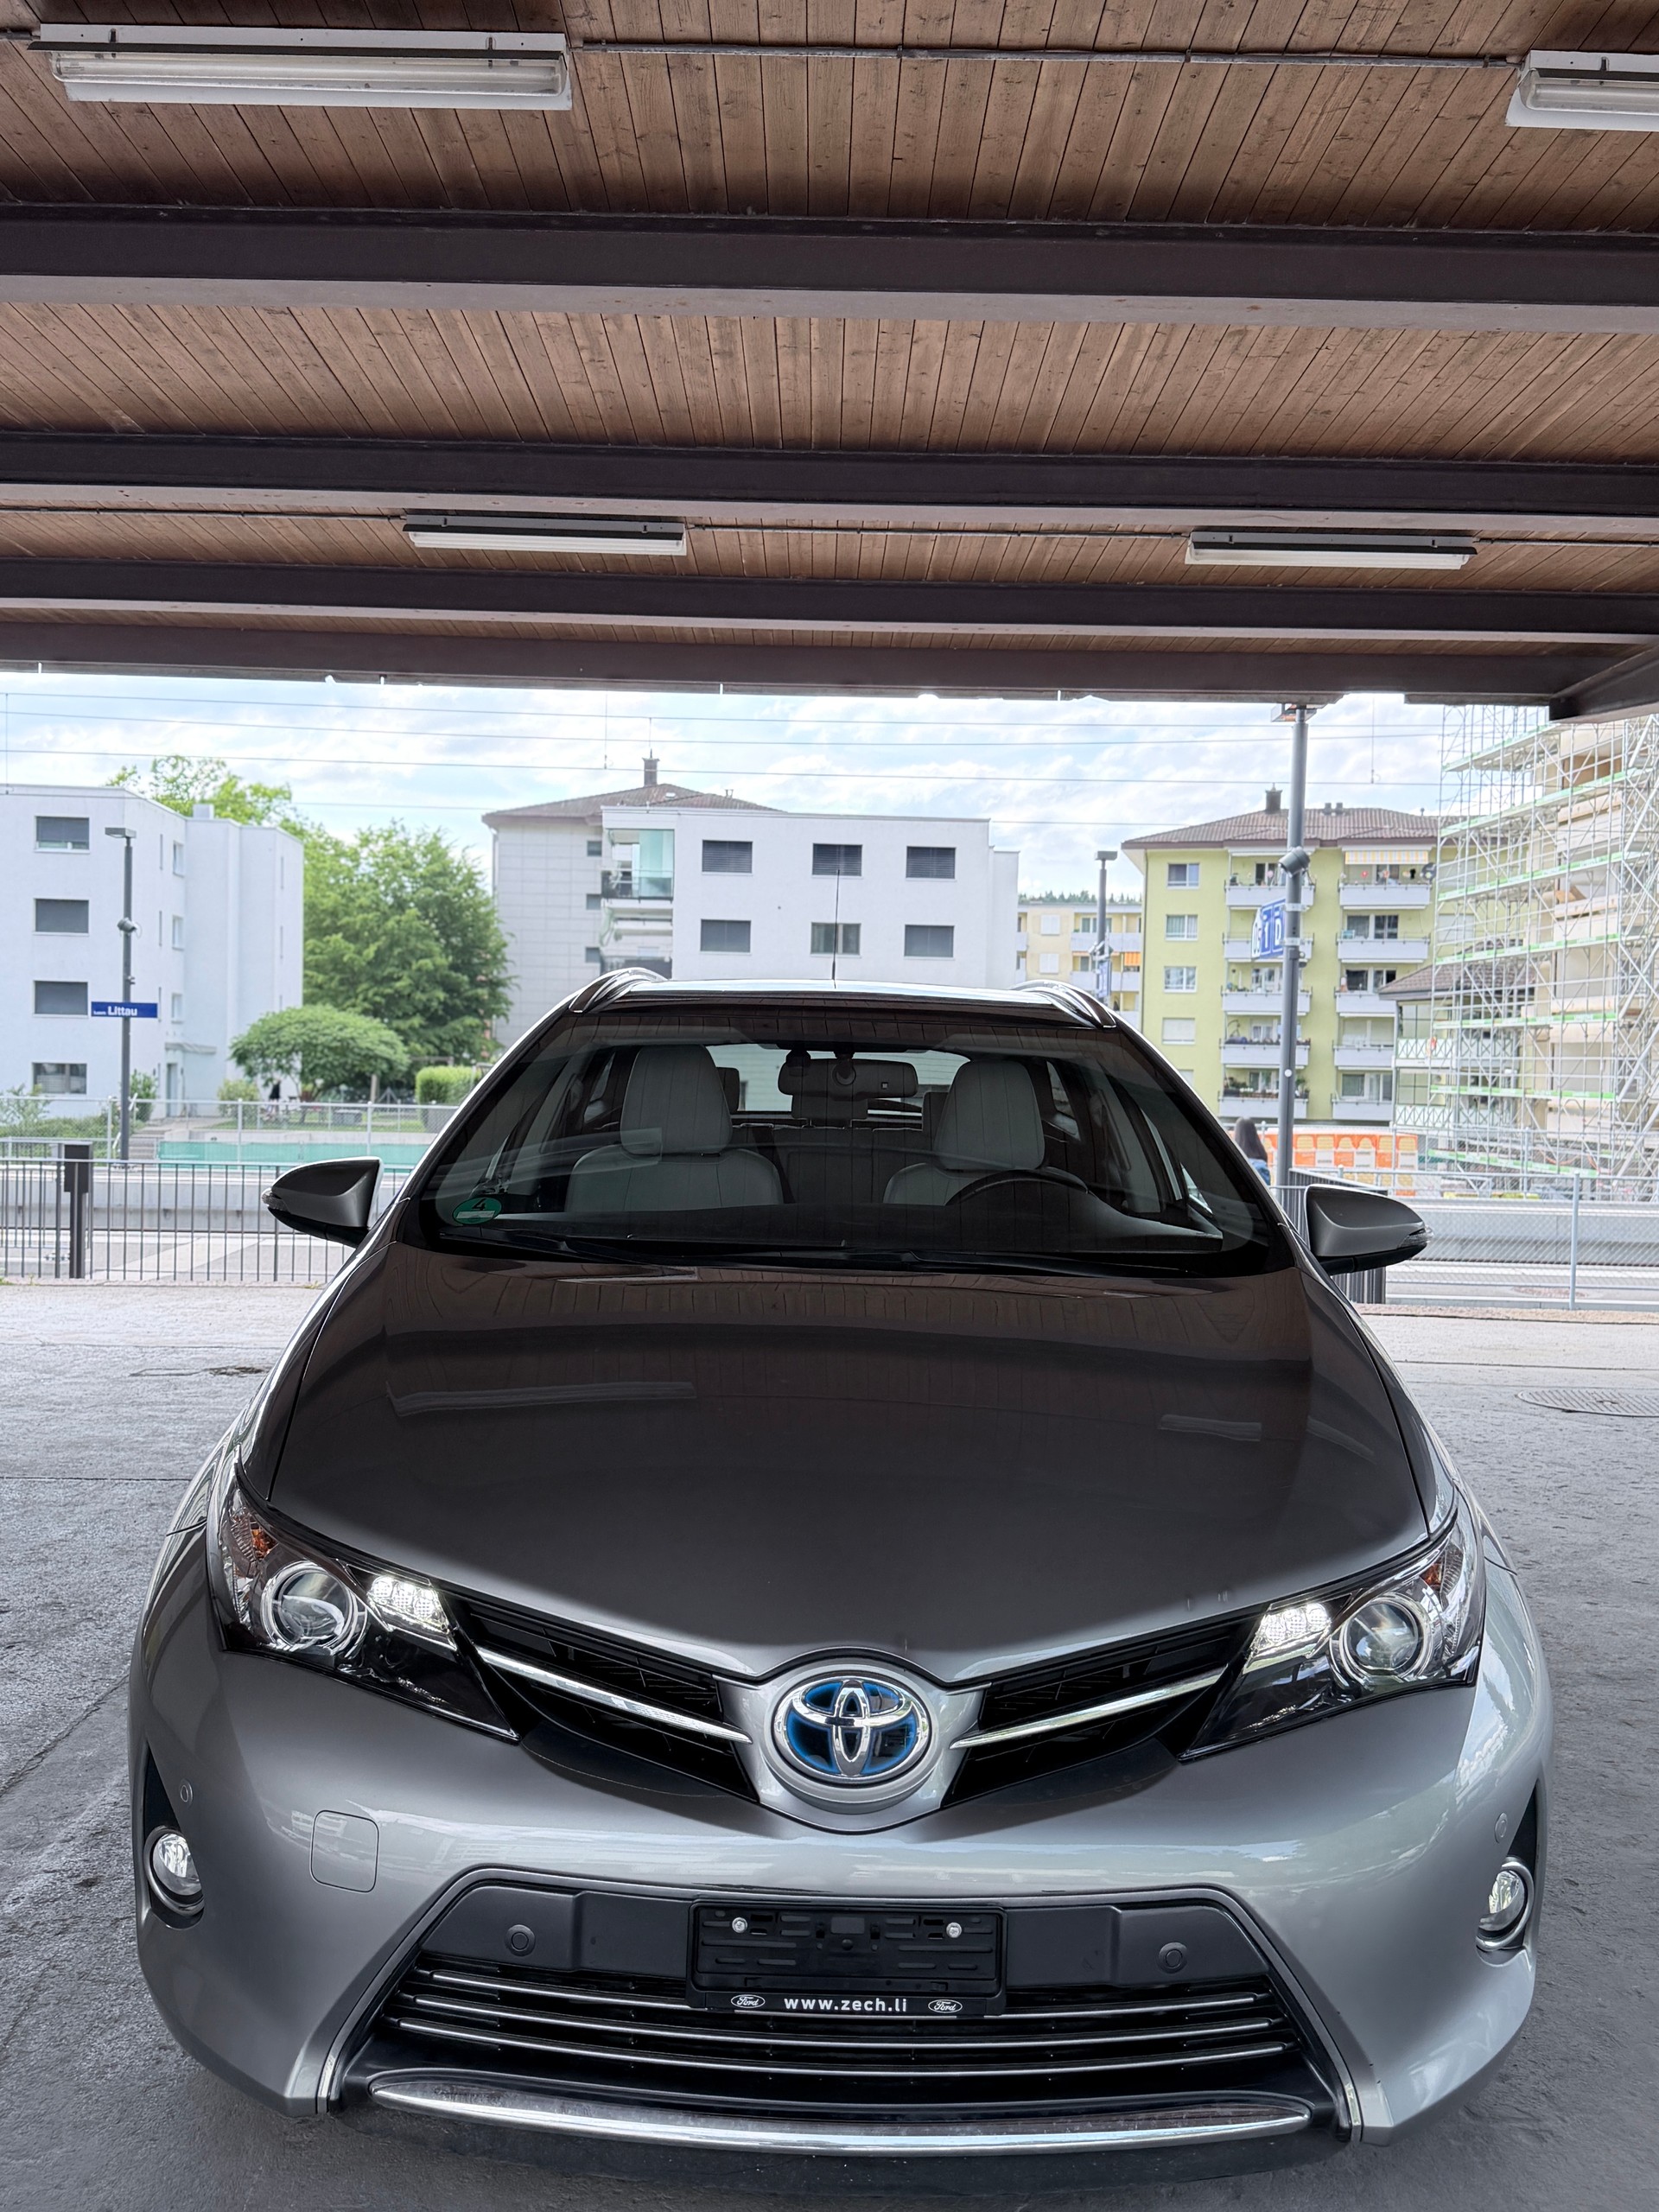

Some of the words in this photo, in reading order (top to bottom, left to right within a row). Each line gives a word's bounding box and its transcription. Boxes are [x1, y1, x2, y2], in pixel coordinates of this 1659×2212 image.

[107, 1005, 138, 1016] Littau
[472, 1198, 486, 1211] 4
[736, 1996, 760, 2006] Ford
[784, 1998, 907, 2012] www.zech.li
[933, 2000, 957, 2012] Ford
